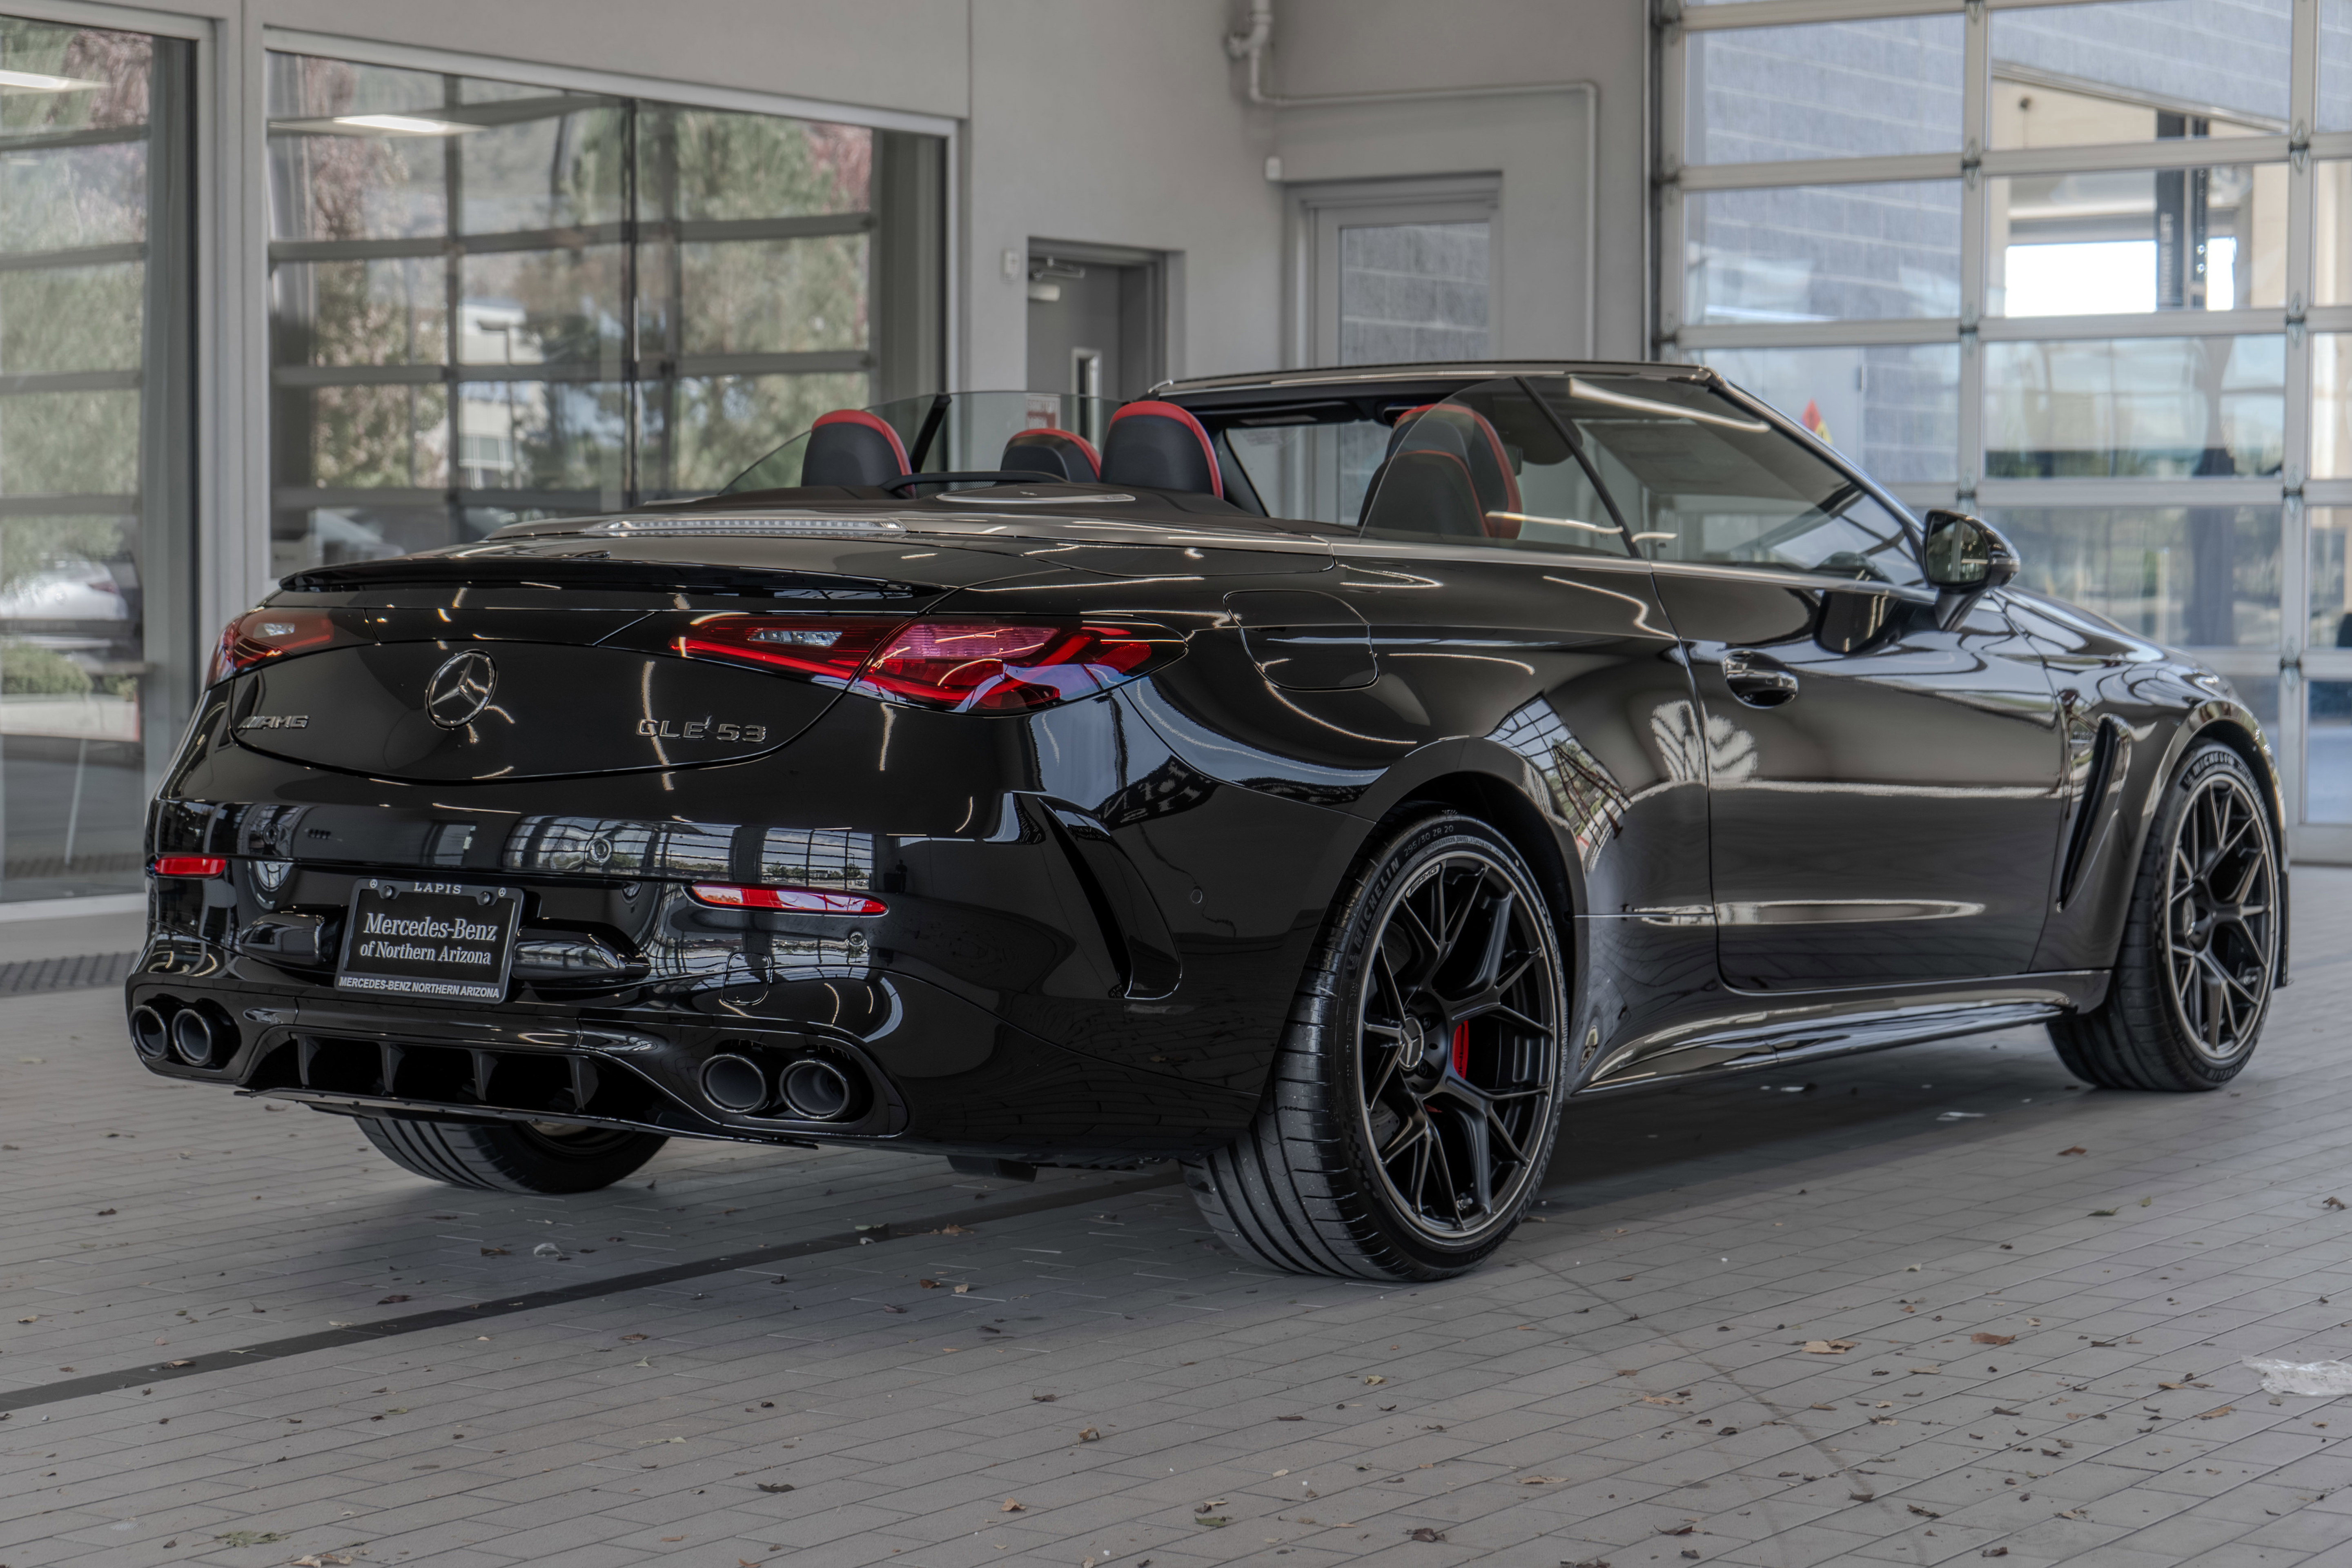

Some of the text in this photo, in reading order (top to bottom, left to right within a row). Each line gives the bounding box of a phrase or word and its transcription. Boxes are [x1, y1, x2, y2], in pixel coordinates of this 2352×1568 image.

[261, 715, 309, 728] AMG
[636, 719, 766, 743] CLE 53
[1418, 868, 1437, 882] AMG
[414, 882, 462, 894] LAPIS
[1354, 858, 1400, 949] MICHELIN
[1403, 833, 1430, 856] 295/30
[1432, 827, 1442, 837] ZR
[1443, 825, 1454, 833] 20
[363, 913, 499, 942] Mercedes-Benz
[360, 941, 491, 965] of Northern Arizona
[339, 976, 499, 998] MERCEDES-BENZ NORTHERN ARIZONA
